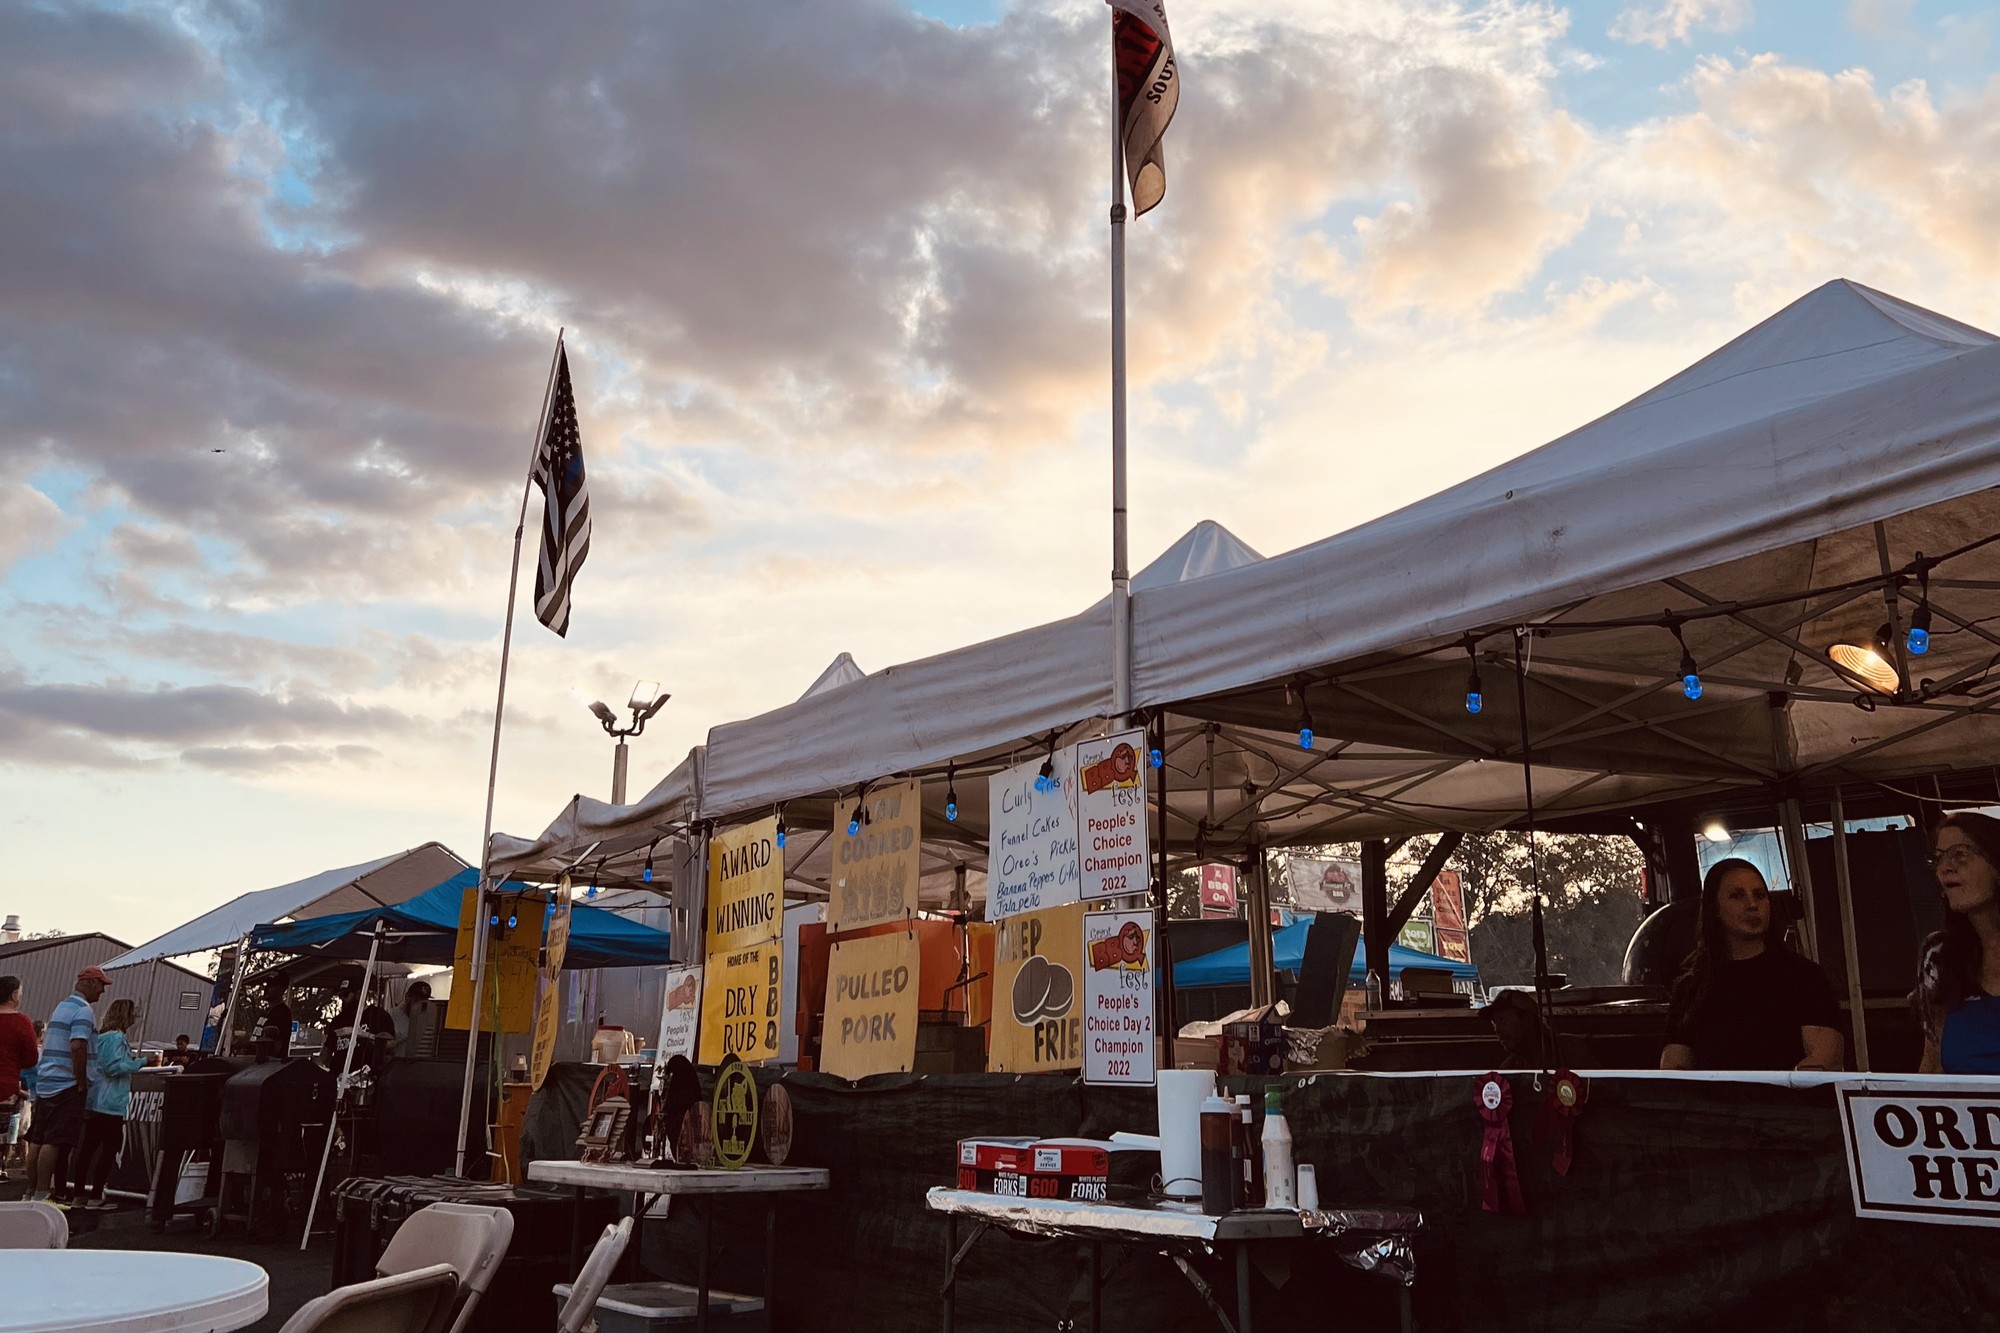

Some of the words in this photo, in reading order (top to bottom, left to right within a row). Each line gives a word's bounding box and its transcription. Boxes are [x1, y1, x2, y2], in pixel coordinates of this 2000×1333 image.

[1002, 782, 1033, 815] Curly
[1112, 782, 1141, 807] fest
[1088, 812, 1136, 832] People's
[840, 825, 914, 865] COOKED
[1001, 824, 1029, 851] Funnel
[1093, 834, 1132, 851] Choice
[720, 839, 771, 882] AWARD
[1003, 851, 1039, 876] Oreo's
[1084, 852, 1142, 872] Champion
[997, 878, 1028, 900] Banana
[1101, 876, 1127, 891] 2022
[1207, 880, 1229, 890] BBQ
[1212, 892, 1225, 903] On
[716, 892, 776, 936] WINNING
[726, 953, 742, 968] HOME
[742, 952, 749, 965] OF
[750, 951, 759, 963] THE
[836, 965, 909, 1003] PULLED
[1119, 963, 1149, 991] fest
[725, 985, 758, 1019] DRY
[765, 955, 780, 1051] BBQ
[1097, 994, 1139, 1013] People's
[666, 1024, 689, 1036] People's
[841, 1012, 897, 1049] PORK
[1087, 1016, 1120, 1032] Choice
[1123, 1016, 1142, 1035] Day
[1145, 1016, 1151, 1032] 2
[666, 1037, 686, 1048] Choice
[723, 1021, 758, 1055] RUB
[1034, 1018, 1083, 1063] FRIE
[1094, 1038, 1144, 1057] Champion
[1107, 1060, 1131, 1077] 2022
[1873, 1104, 2000, 1151] ORD
[959, 1168, 977, 1191] 600
[993, 1177, 1018, 1196] FORKS
[1031, 1178, 1059, 1198] 600
[1908, 1155, 2000, 1202] HE
[1070, 1182, 1107, 1201] FORKS
